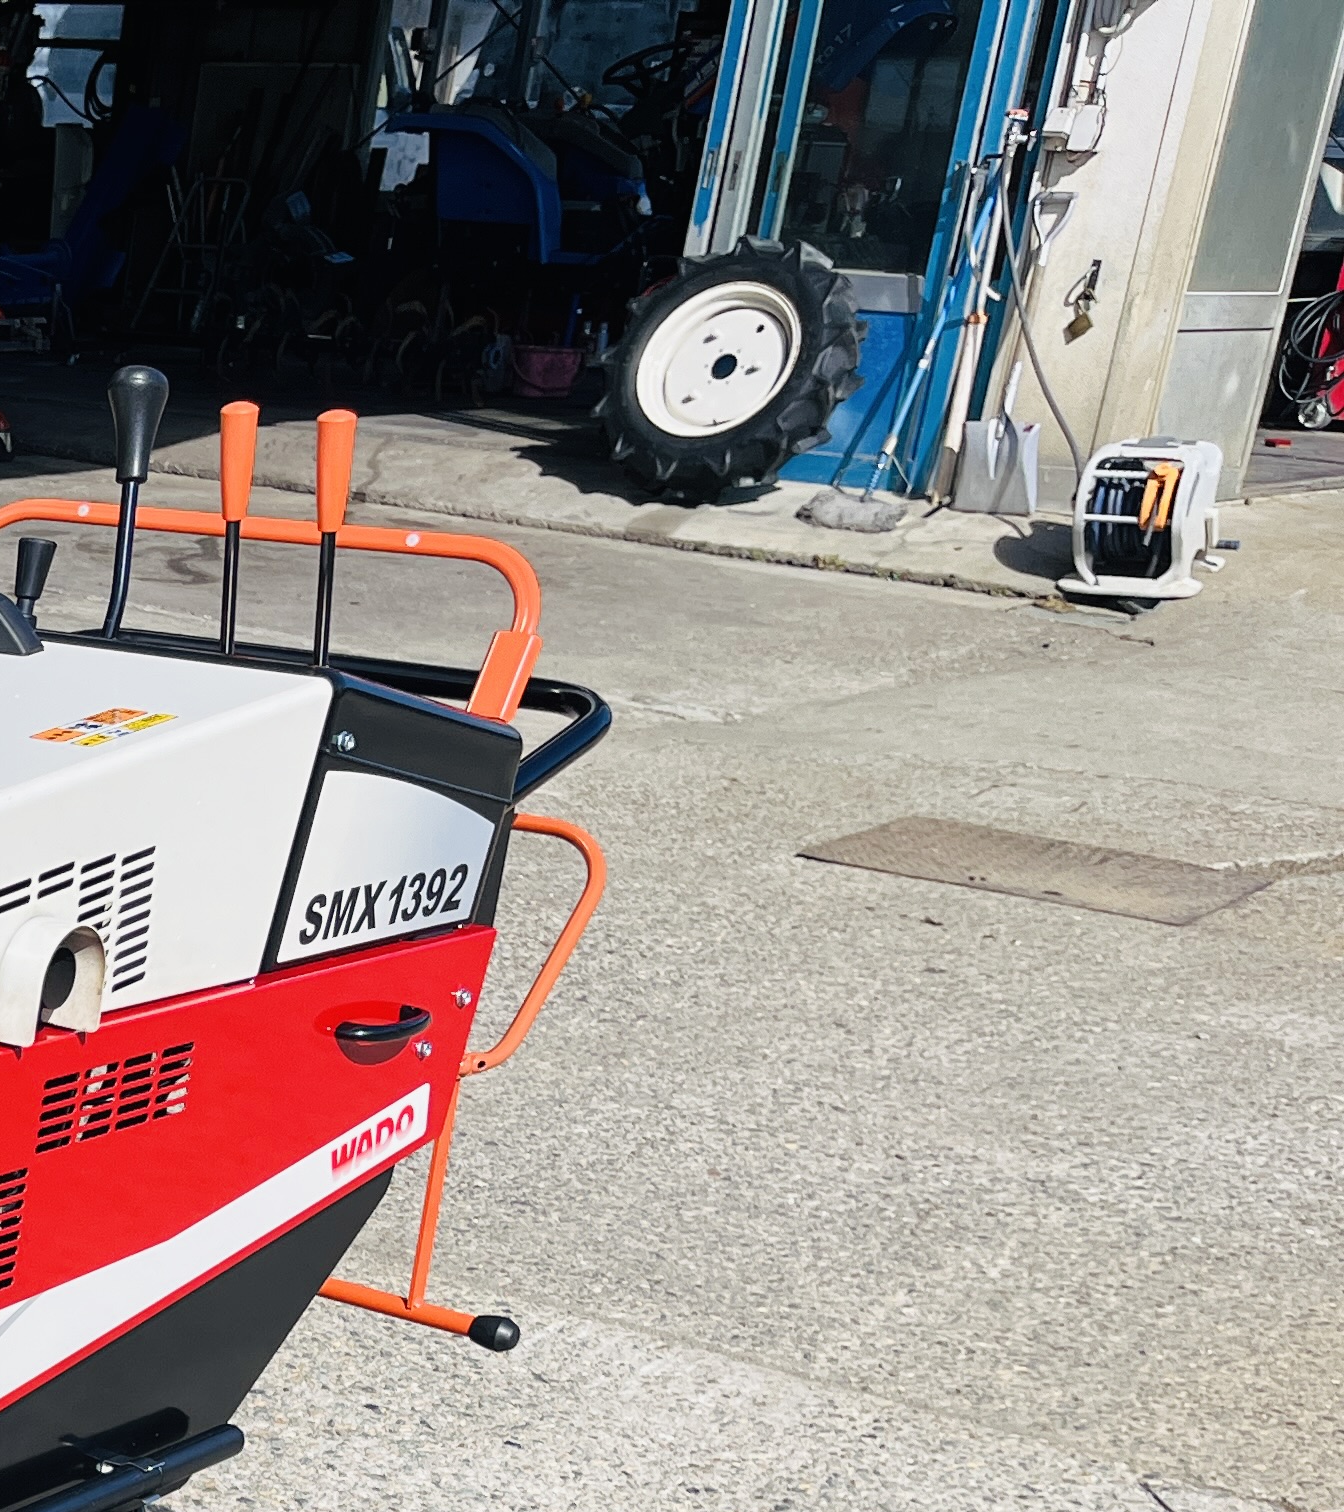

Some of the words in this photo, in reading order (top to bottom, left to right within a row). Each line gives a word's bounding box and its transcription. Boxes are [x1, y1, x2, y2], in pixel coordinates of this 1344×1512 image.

[298, 879, 388, 946] SMX
[387, 863, 470, 926] 1392
[330, 1103, 415, 1181] WADO
